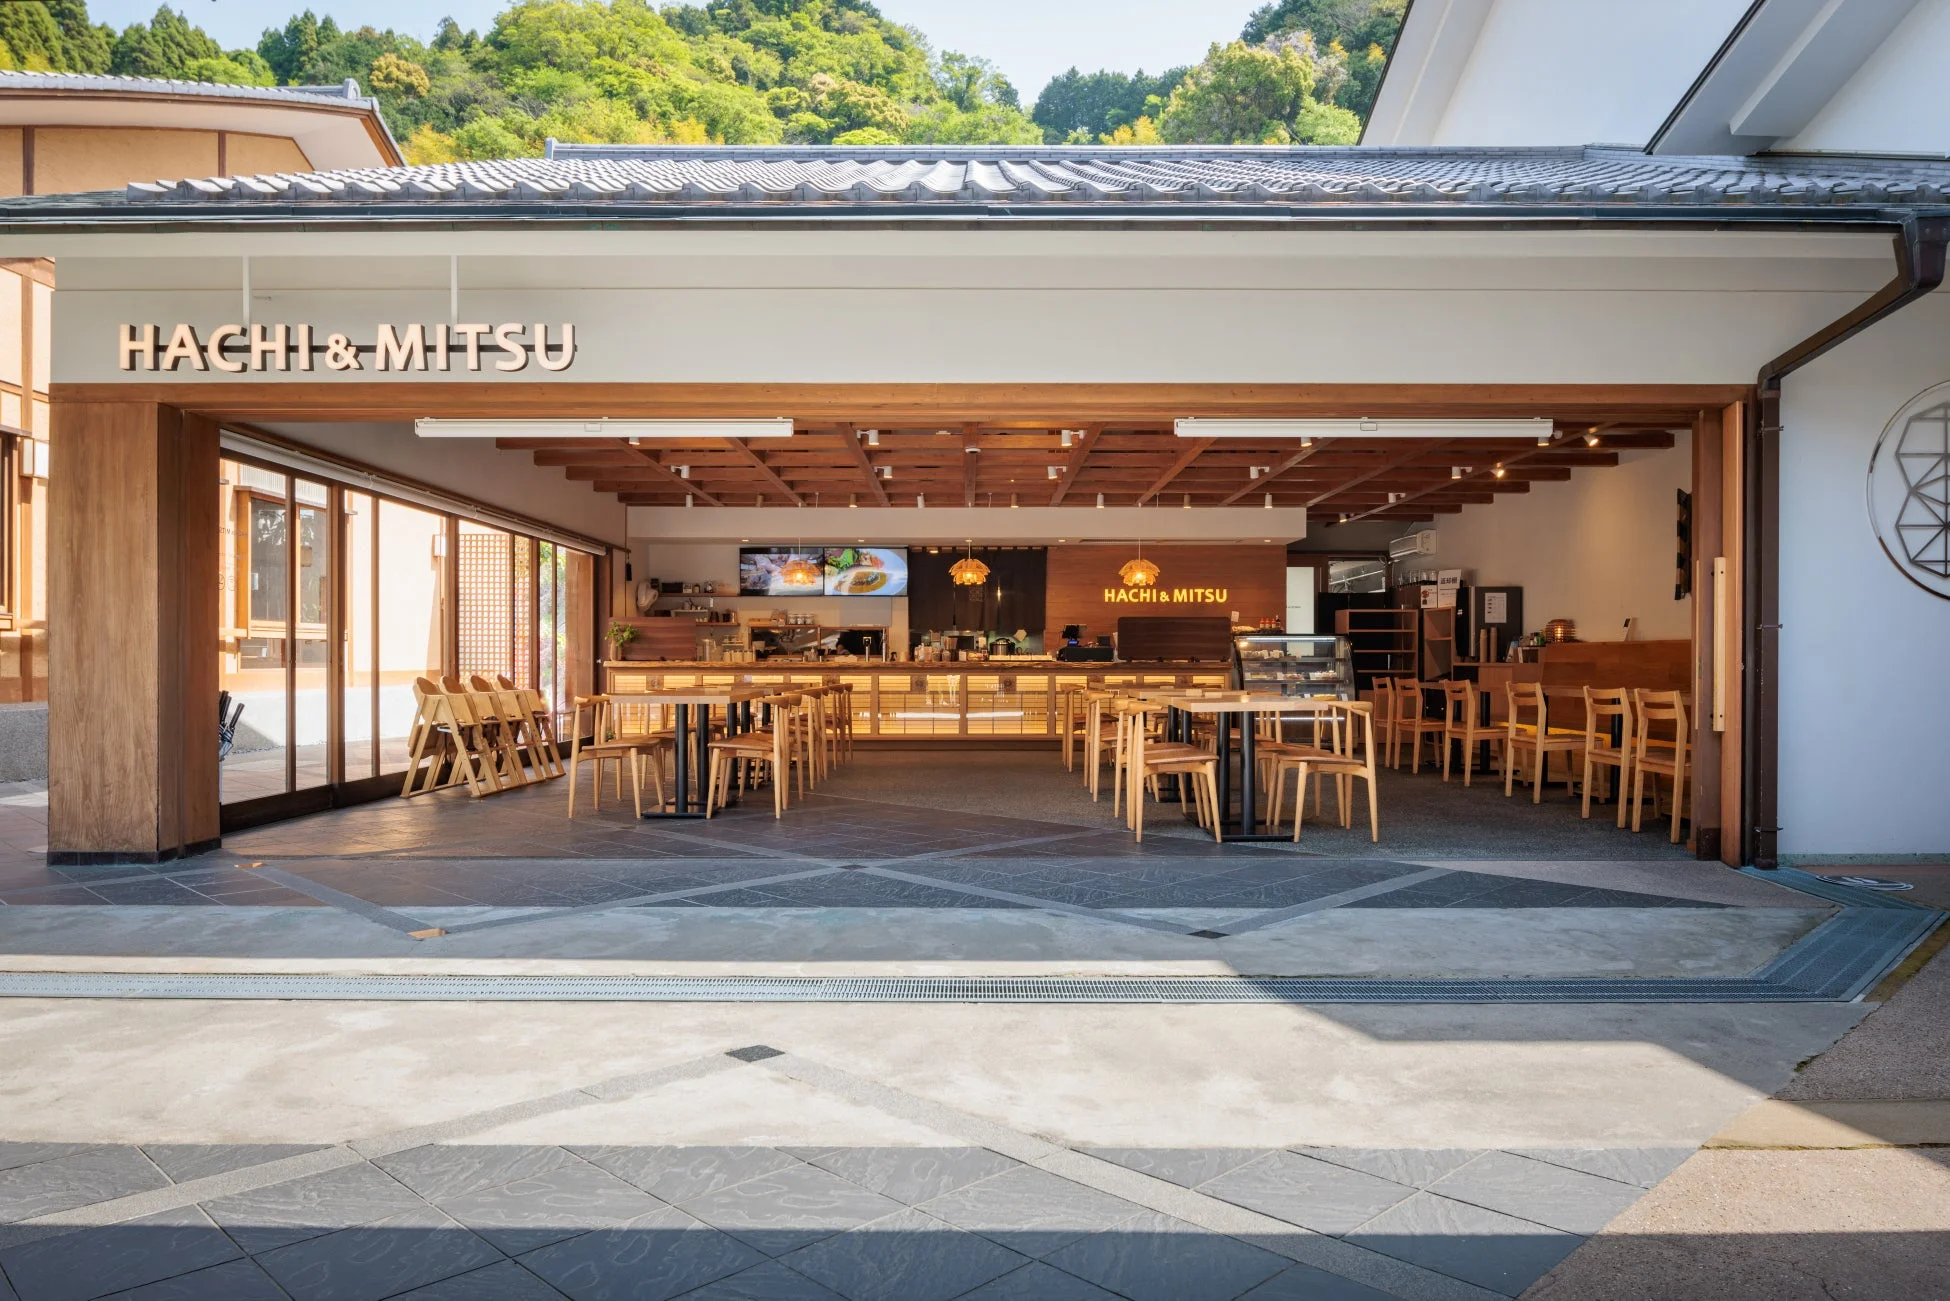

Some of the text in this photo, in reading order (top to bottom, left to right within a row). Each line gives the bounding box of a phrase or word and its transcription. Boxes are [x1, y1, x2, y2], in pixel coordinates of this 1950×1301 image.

[119, 323, 576, 372] HACHI & MITSU
[1104, 588, 1228, 603] HACHI & MITSU
